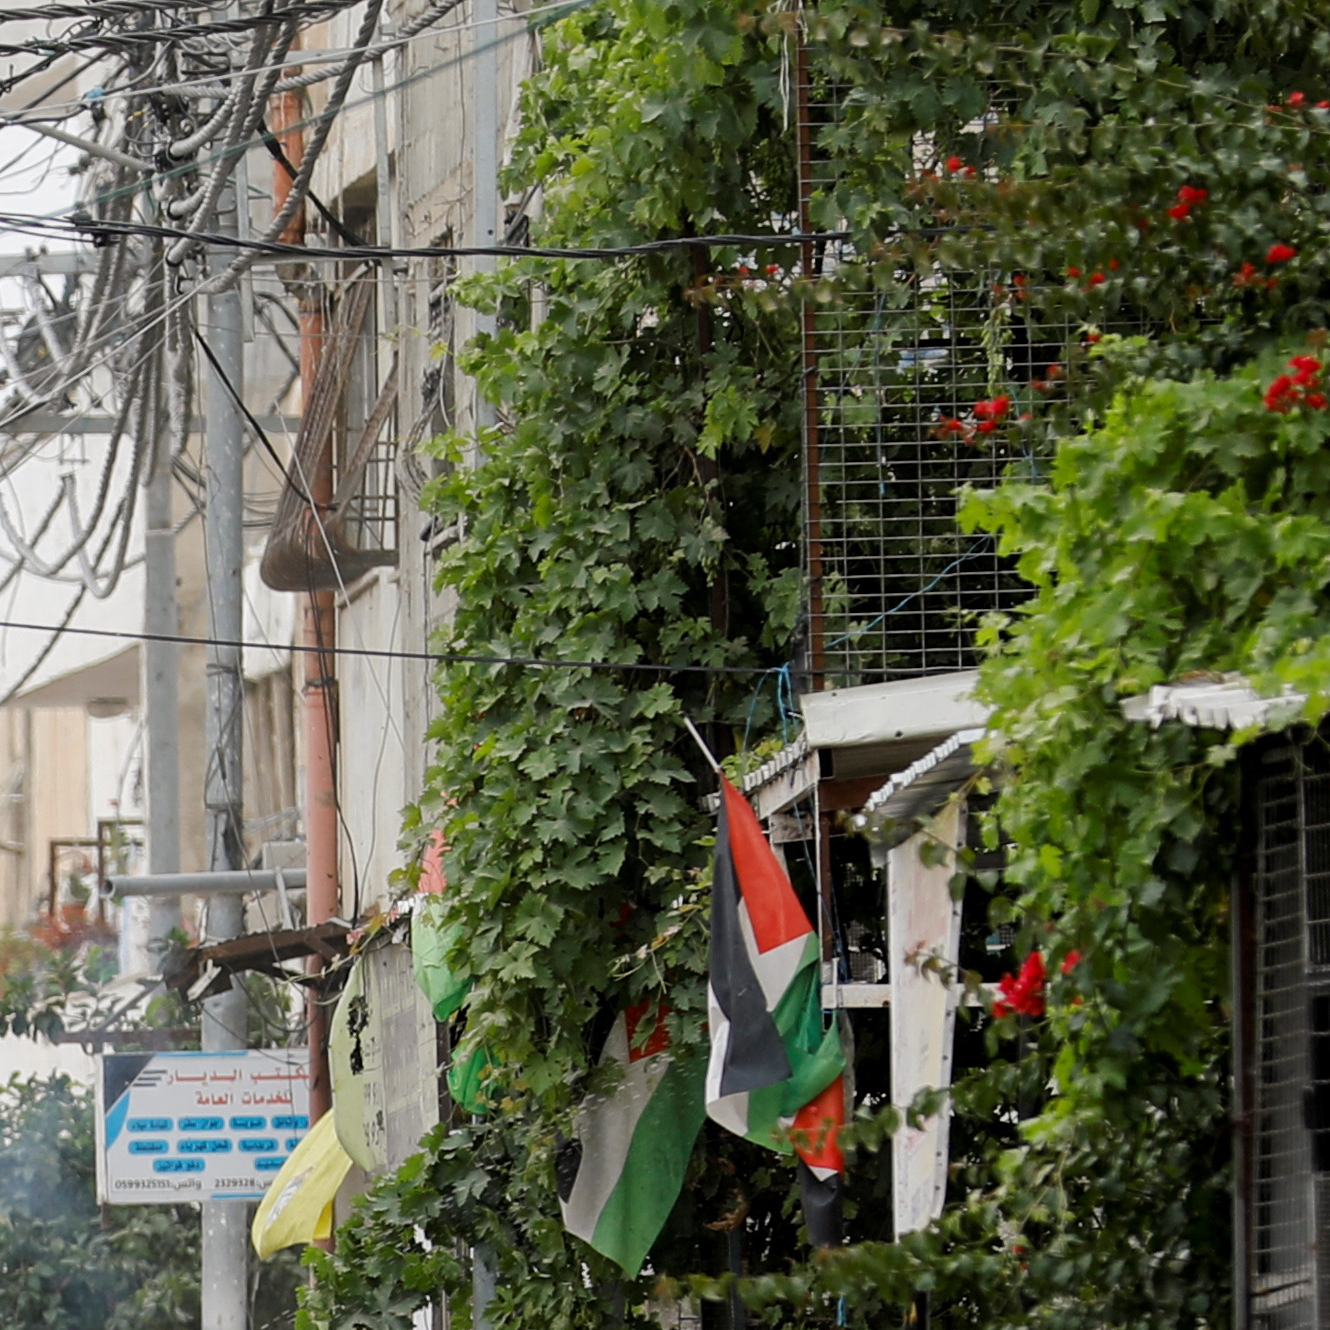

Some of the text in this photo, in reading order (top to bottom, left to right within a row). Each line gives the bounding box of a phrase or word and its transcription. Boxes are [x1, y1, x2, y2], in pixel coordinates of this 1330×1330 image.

[166, 1067, 310, 1086] كتب الديار
[195, 1090, 293, 1105] للخدمات العامة
